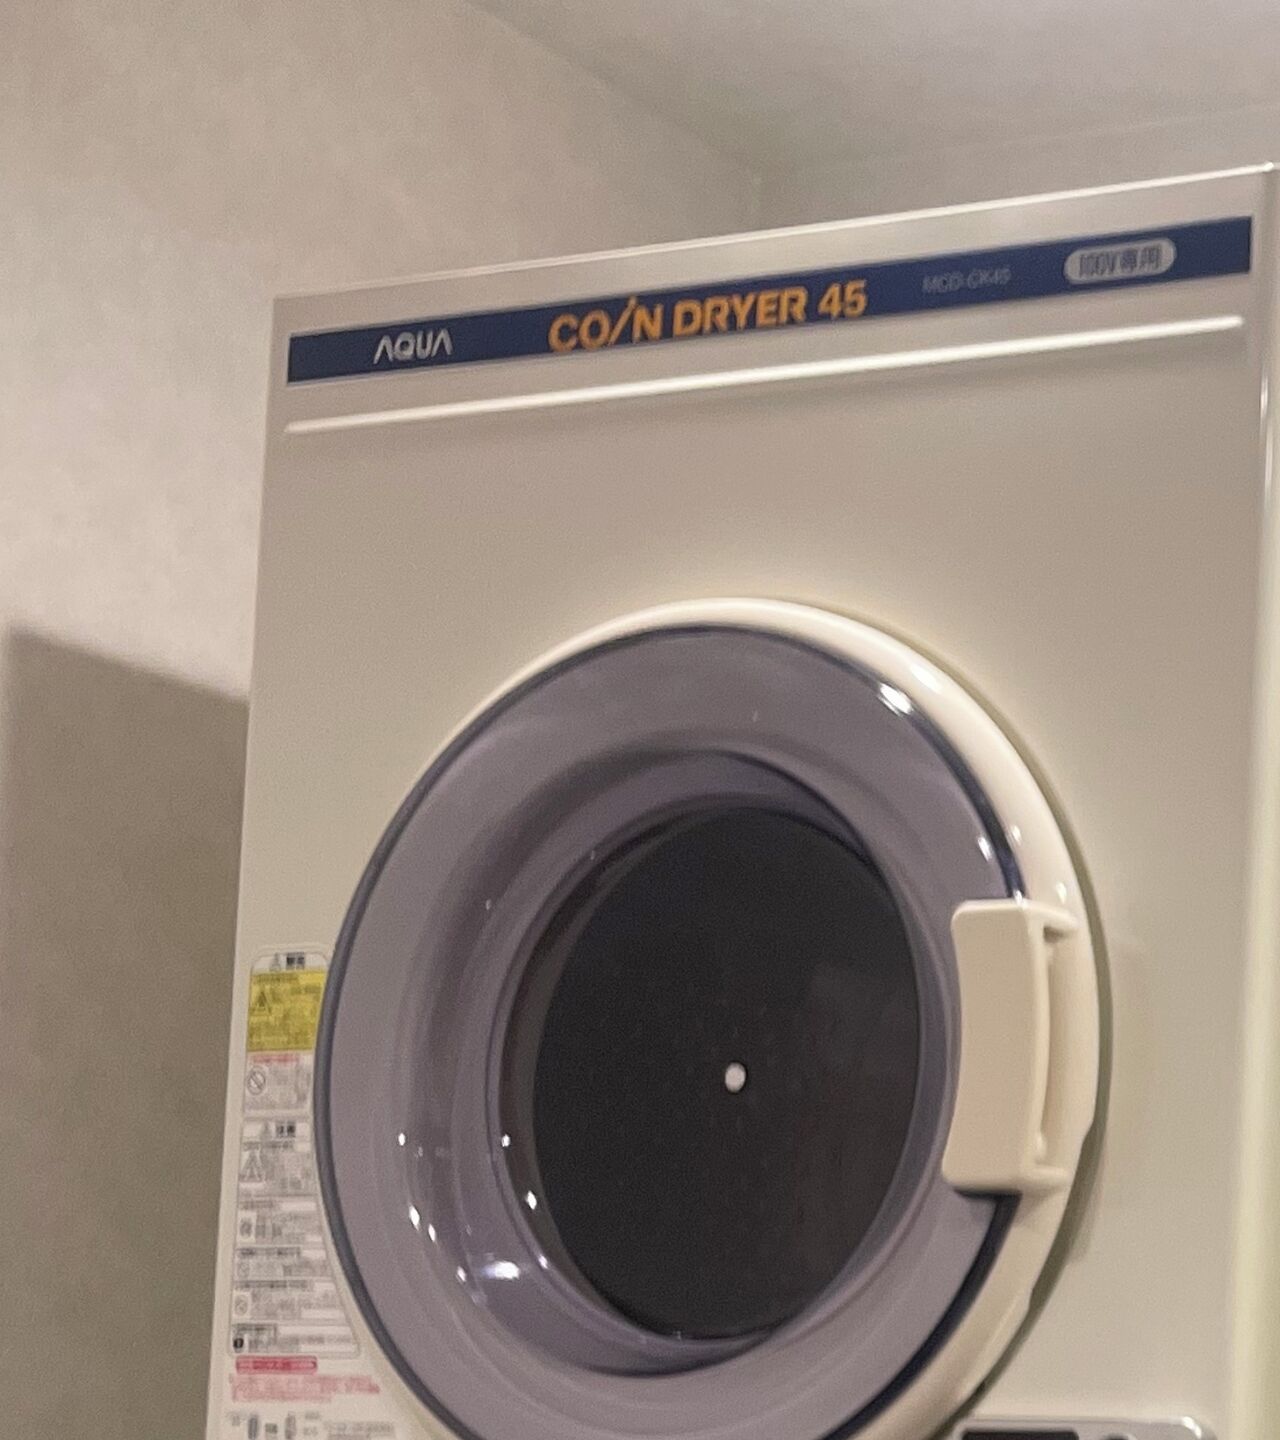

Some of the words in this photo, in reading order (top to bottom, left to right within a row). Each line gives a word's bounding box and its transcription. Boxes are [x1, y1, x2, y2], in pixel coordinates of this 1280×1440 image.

[373, 328, 453, 365] AQUA
[547, 295, 663, 352] COIN
[671, 286, 808, 338] DRYER
[818, 279, 867, 319] 45
